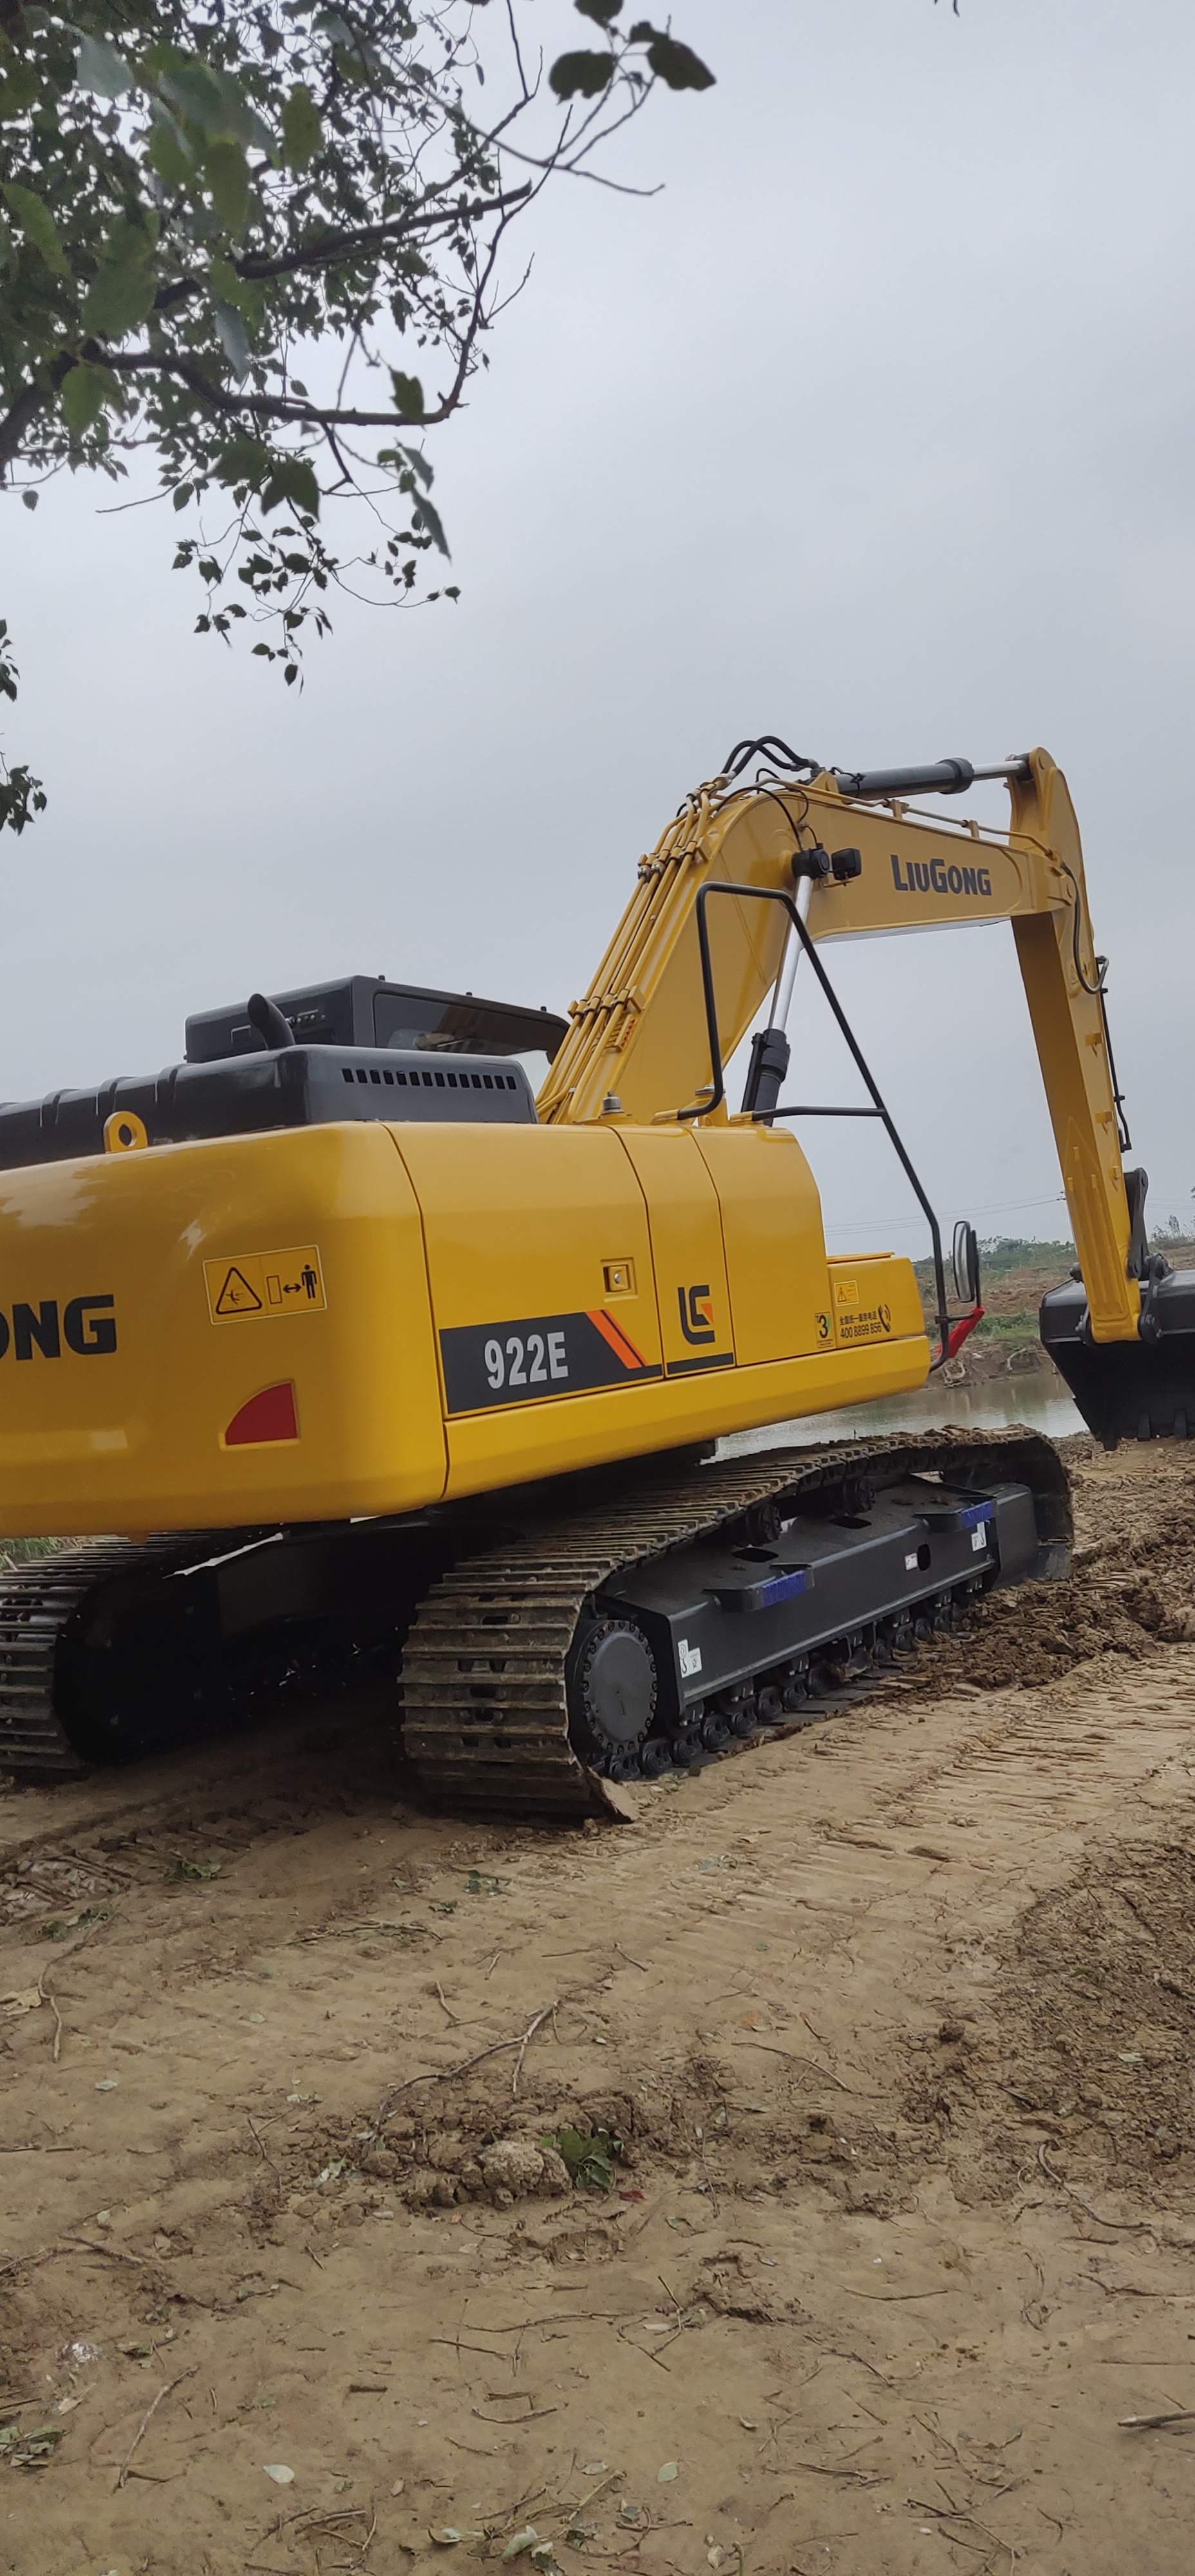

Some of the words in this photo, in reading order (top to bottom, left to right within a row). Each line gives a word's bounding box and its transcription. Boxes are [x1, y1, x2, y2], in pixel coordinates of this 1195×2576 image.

[0, 1294, 117, 1360] NG
[818, 1314, 829, 1339] 3
[840, 1327, 853, 1339] 400
[484, 1331, 569, 1389] 922E
